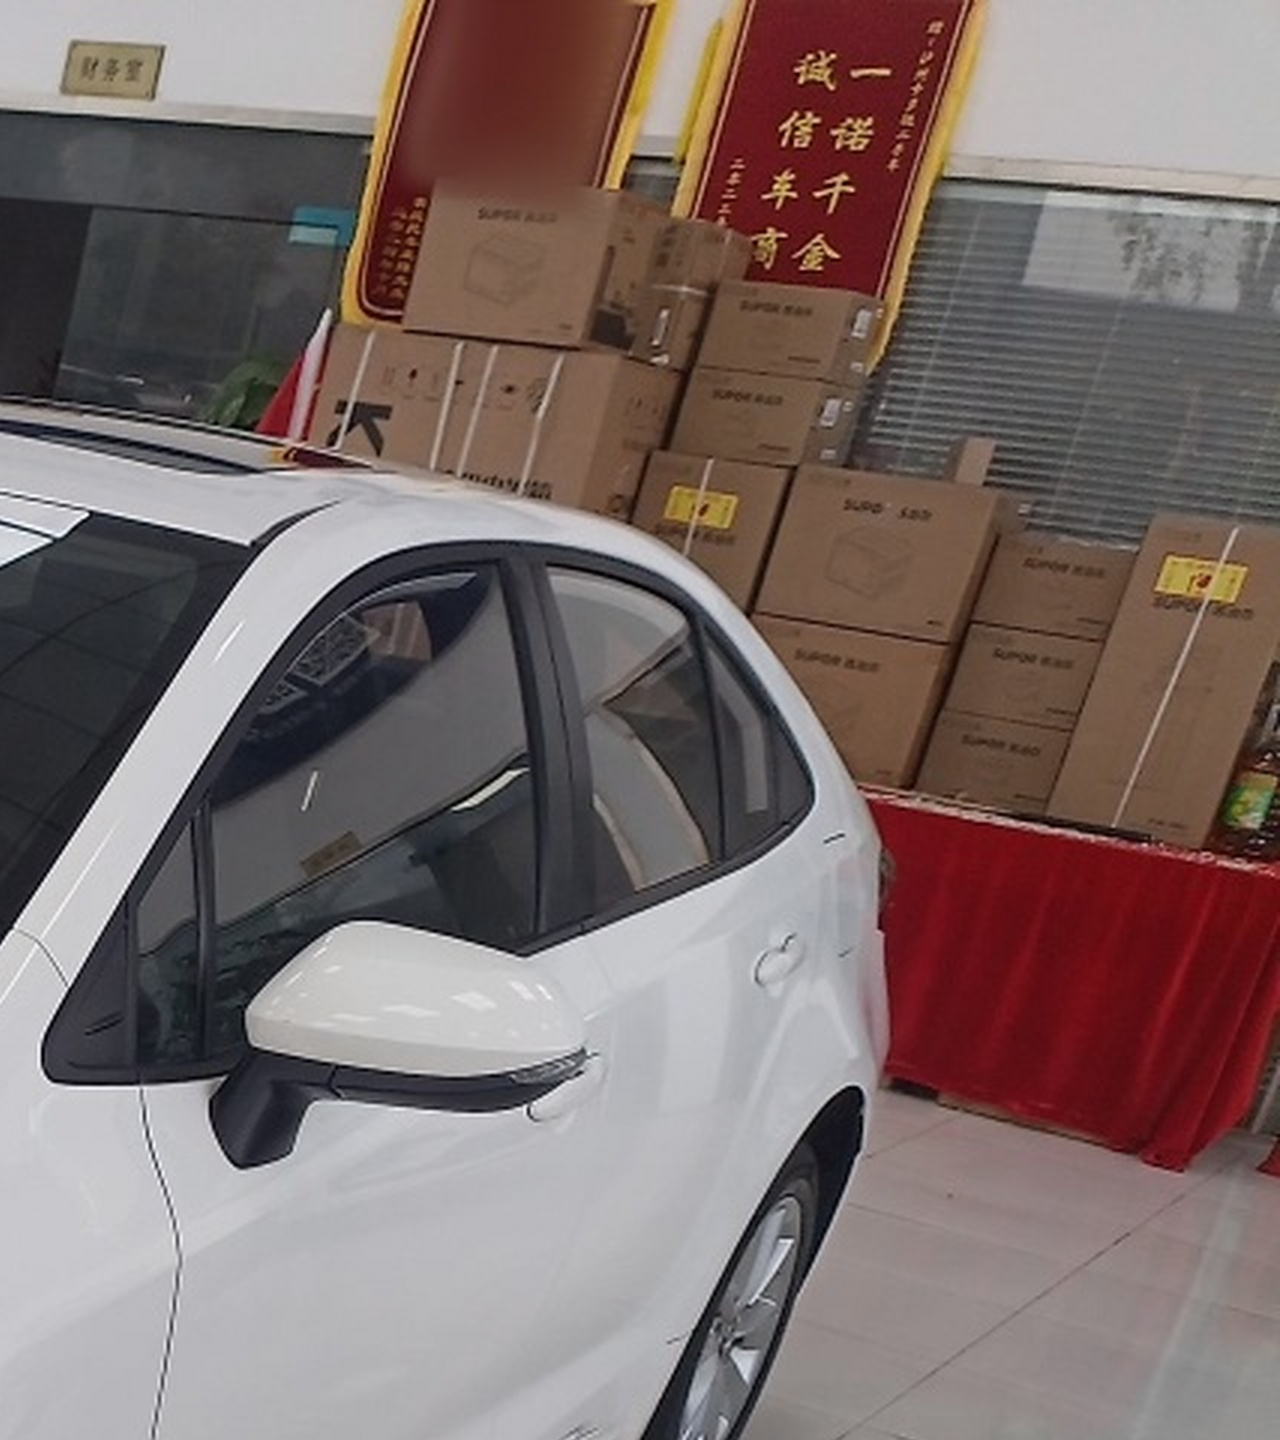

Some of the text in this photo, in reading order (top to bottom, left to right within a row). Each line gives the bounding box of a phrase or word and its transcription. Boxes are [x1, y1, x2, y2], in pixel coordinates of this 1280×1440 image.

[81, 56, 143, 82] 财务室
[792, 67, 892, 271] 一诺千金
[843, 498, 892, 516] SUPO
